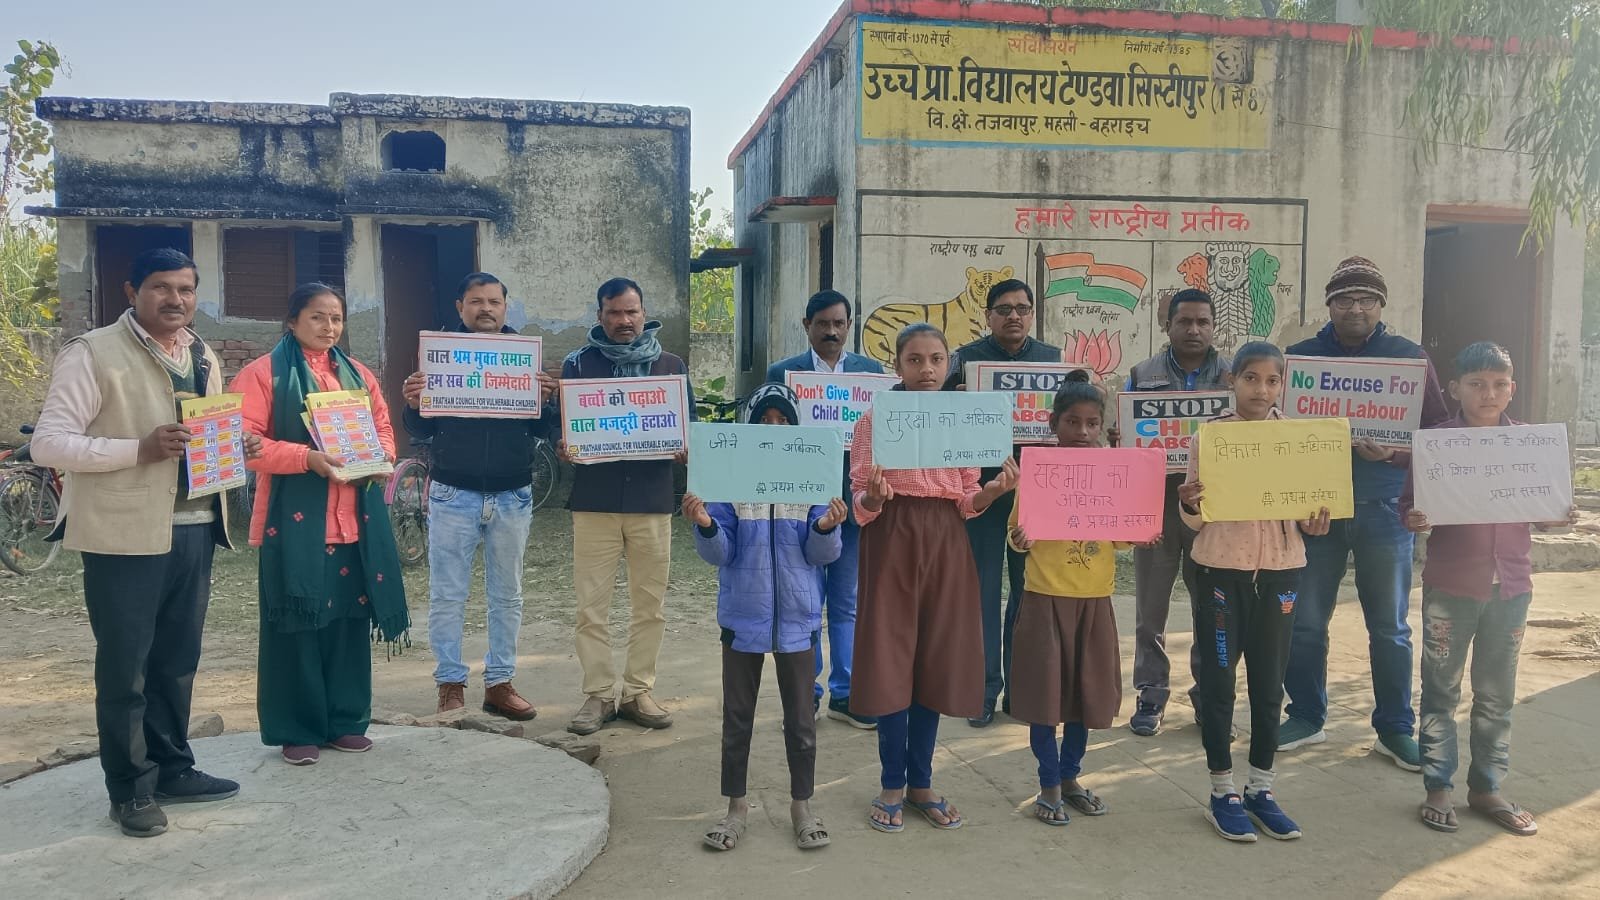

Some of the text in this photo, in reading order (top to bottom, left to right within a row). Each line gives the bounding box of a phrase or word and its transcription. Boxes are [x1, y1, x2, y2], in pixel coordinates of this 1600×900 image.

[864, 62, 920, 101] उच्च
[958, 55, 1060, 104] विद्यालय
[925, 106, 949, 129] वि.
[951, 108, 971, 133] क्षे.
[1044, 109, 1078, 135] महसी
[1088, 116, 1152, 138] बहराइच
[1014, 202, 1250, 237] हमारे राष्ट्रीय प्रतीक
[930, 239, 961, 256] राष्ट्रीय
[1062, 303, 1085, 318] राष्ट्रीय
[427, 349, 450, 363] बाल
[453, 350, 471, 365] श्रम
[500, 352, 533, 367] समाज
[427, 371, 532, 391] हम सब की जिम्मेदारी
[1291, 370, 1419, 396] No Excuse For
[432, 396, 454, 405] PRATHAM
[477, 397, 486, 406] FOR
[486, 398, 514, 407] VULNERABLE
[515, 399, 537, 408] CHILDREN
[577, 386, 667, 408] बच्चों को पढ़ाओ
[795, 383, 823, 400] Don't
[826, 384, 850, 401] Give
[812, 404, 839, 421] Child
[1141, 398, 1223, 417] STOP
[1296, 395, 1408, 421] Child Labour
[570, 410, 677, 435] बाल मजदूरी हटाओ
[885, 407, 1006, 442] सुरक्षा का अधिकार
[580, 443, 600, 452] PRATHAM
[622, 441, 633, 450] FOR
[633, 440, 661, 449] VULNERABLE
[661, 439, 683, 448] CHILDREN
[709, 432, 826, 456] जीने का अधिकार
[1213, 433, 1344, 463] विकास का अधिकार
[1425, 438, 1440, 451] हर
[1480, 437, 1494, 447] का
[1517, 432, 1560, 448] अधिकार
[1106, 464, 1129, 489] का
[770, 481, 795, 493] प्रथम
[1055, 490, 1115, 510] अधिकार
